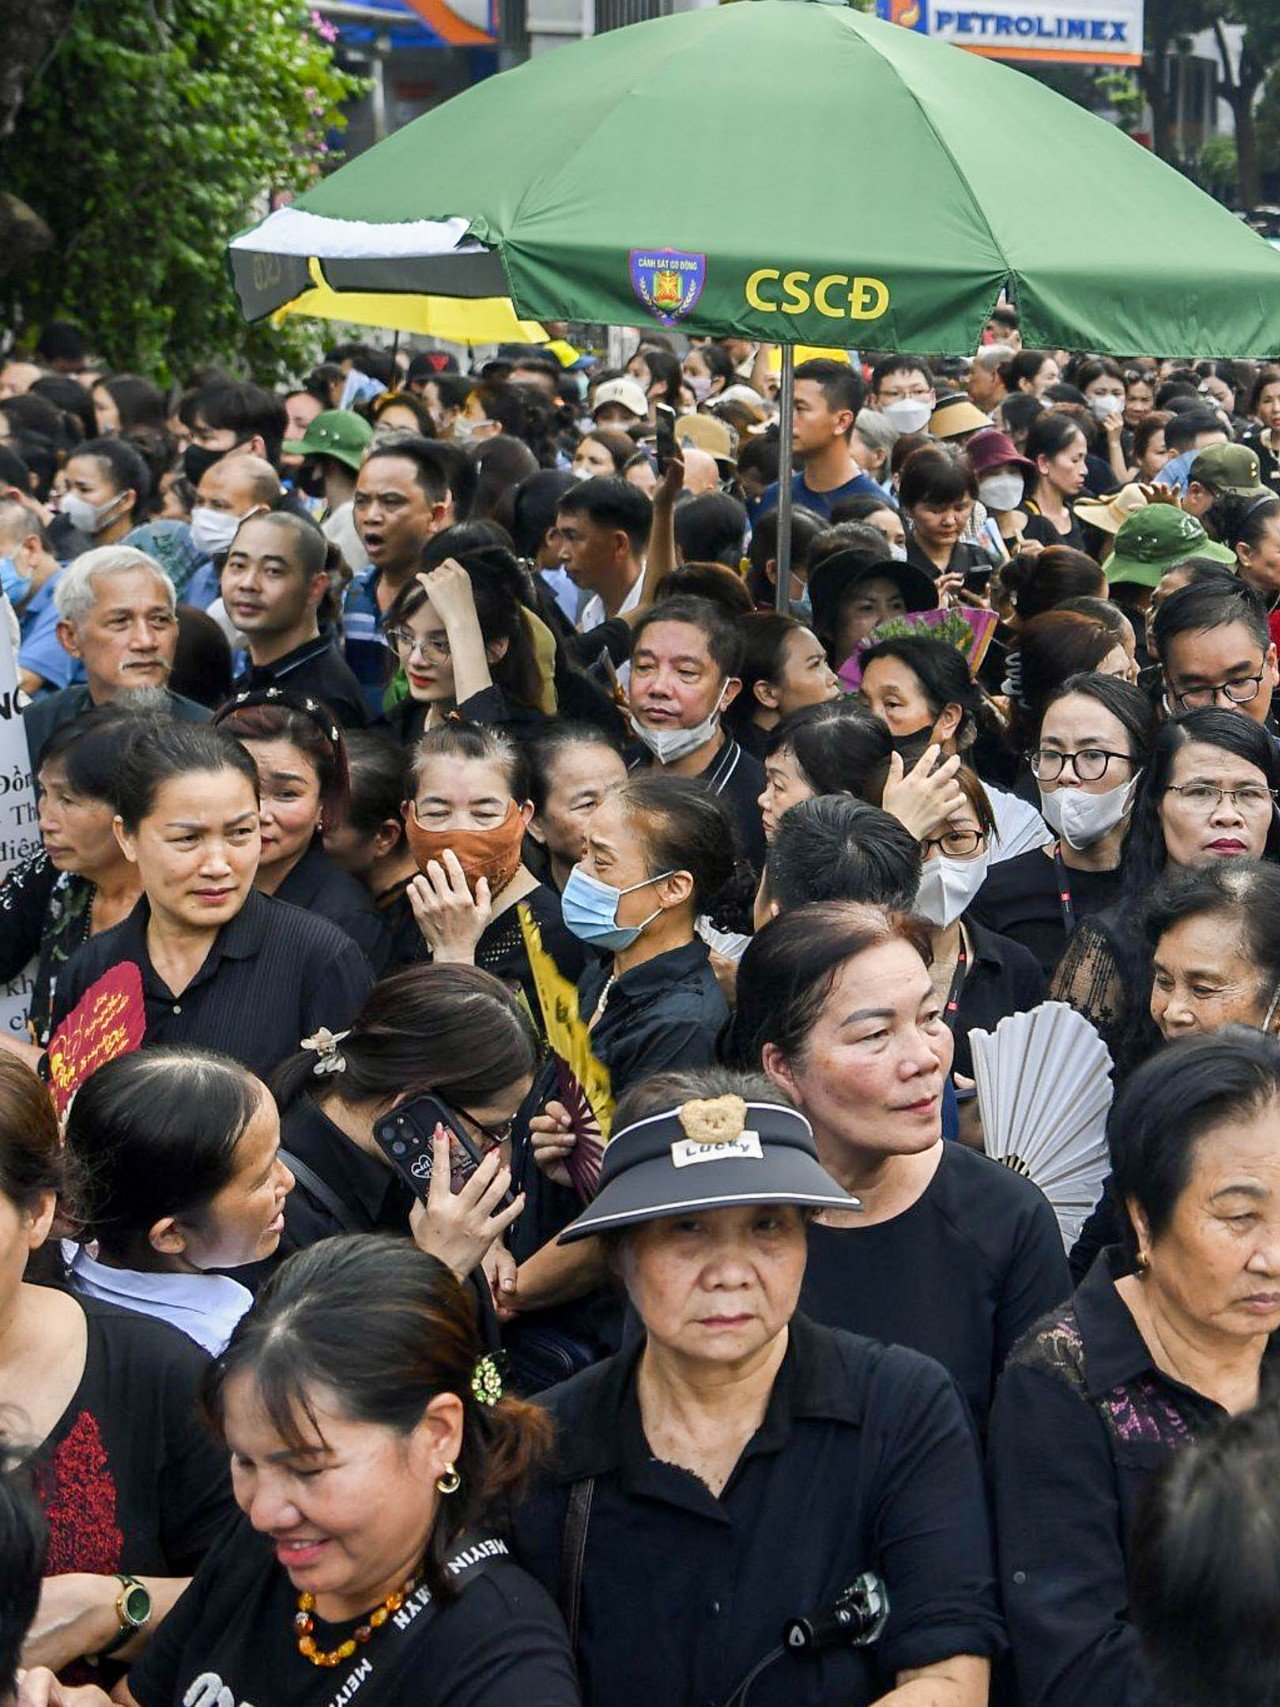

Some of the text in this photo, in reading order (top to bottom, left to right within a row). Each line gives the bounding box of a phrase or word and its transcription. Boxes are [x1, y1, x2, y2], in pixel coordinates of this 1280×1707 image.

[936, 10, 1127, 42] PETROLIMEX
[745, 268, 890, 320] CSCĐ
[447, 1539, 509, 1575] MEIYIN
